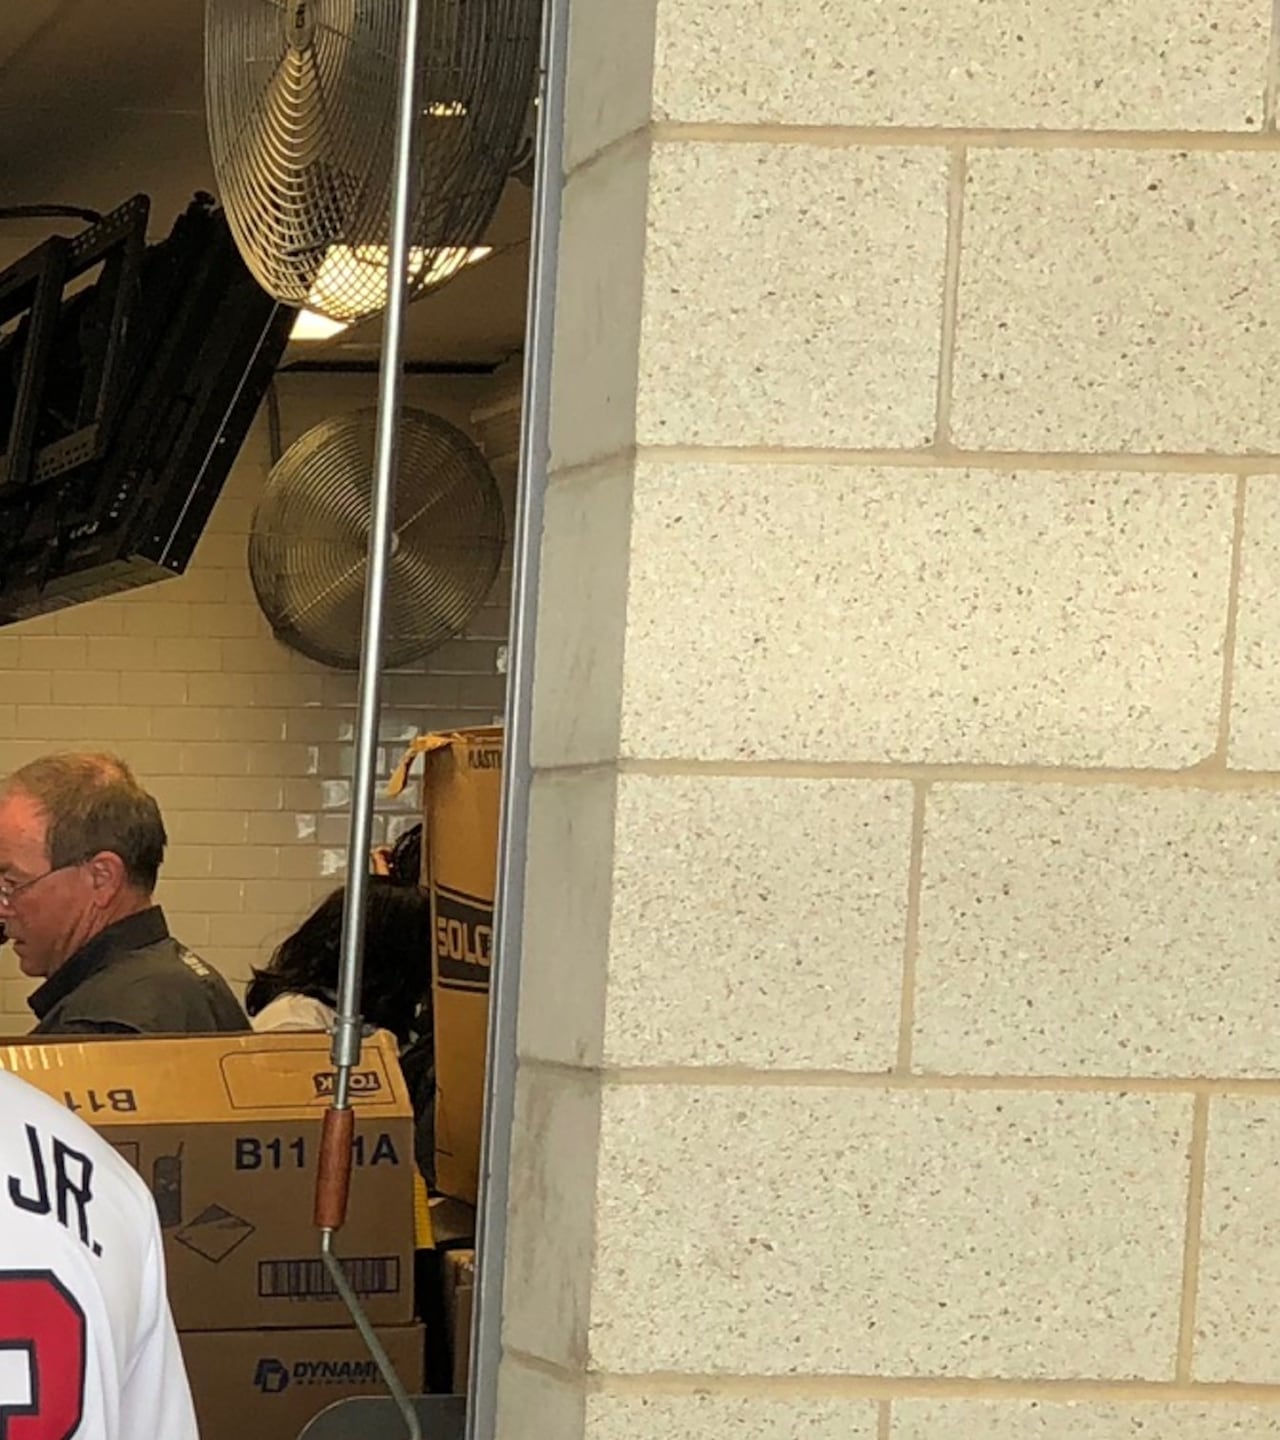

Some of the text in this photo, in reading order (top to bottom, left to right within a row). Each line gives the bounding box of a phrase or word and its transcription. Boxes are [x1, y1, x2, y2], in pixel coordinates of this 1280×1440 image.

[316, 1073, 380, 1092] TOK
[236, 1133, 400, 1171] B111A
[7, 1123, 104, 1257] JR.
